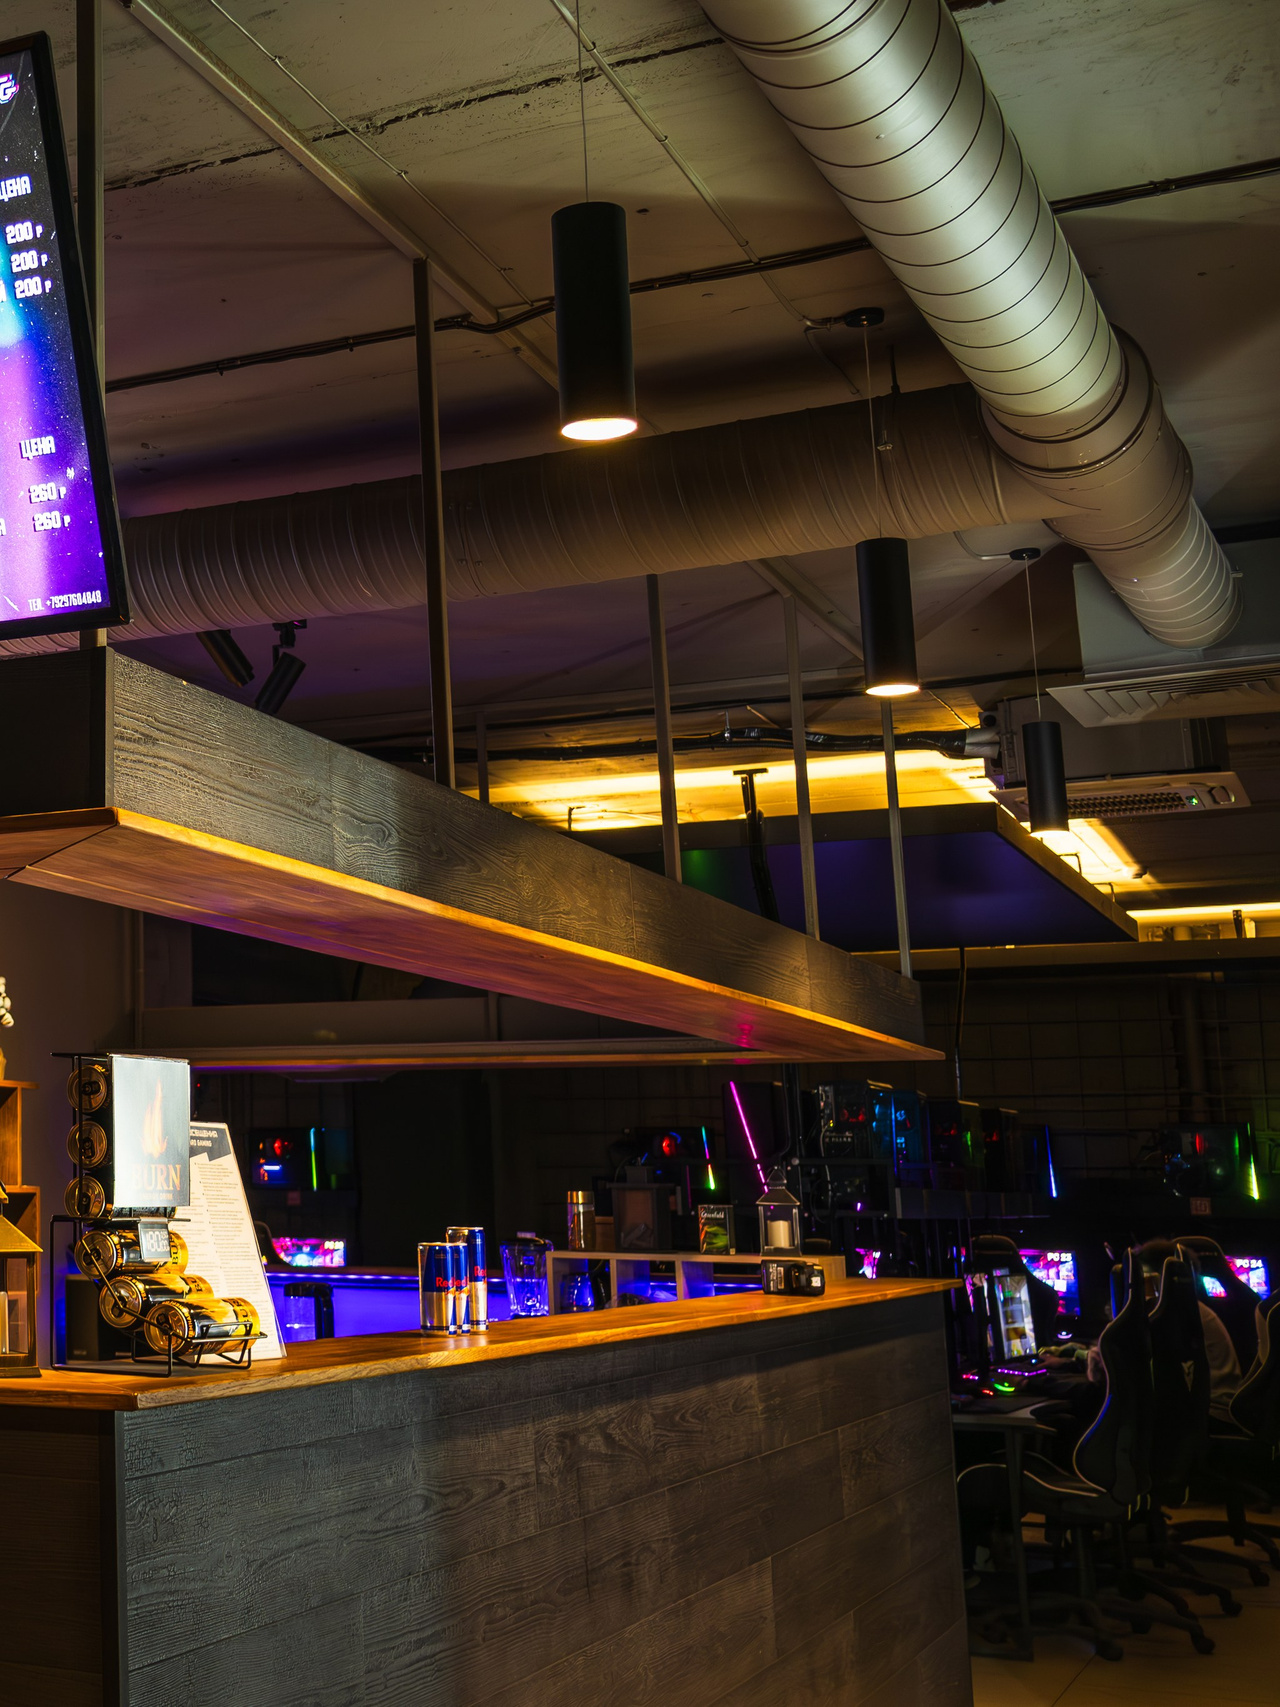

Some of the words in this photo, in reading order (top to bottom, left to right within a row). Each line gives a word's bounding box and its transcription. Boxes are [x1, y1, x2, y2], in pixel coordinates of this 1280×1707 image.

[5, 222, 32, 243] 200
[10, 251, 37, 271] 200
[14, 277, 42, 297] 200
[20, 436, 55, 459] ЦЕНА
